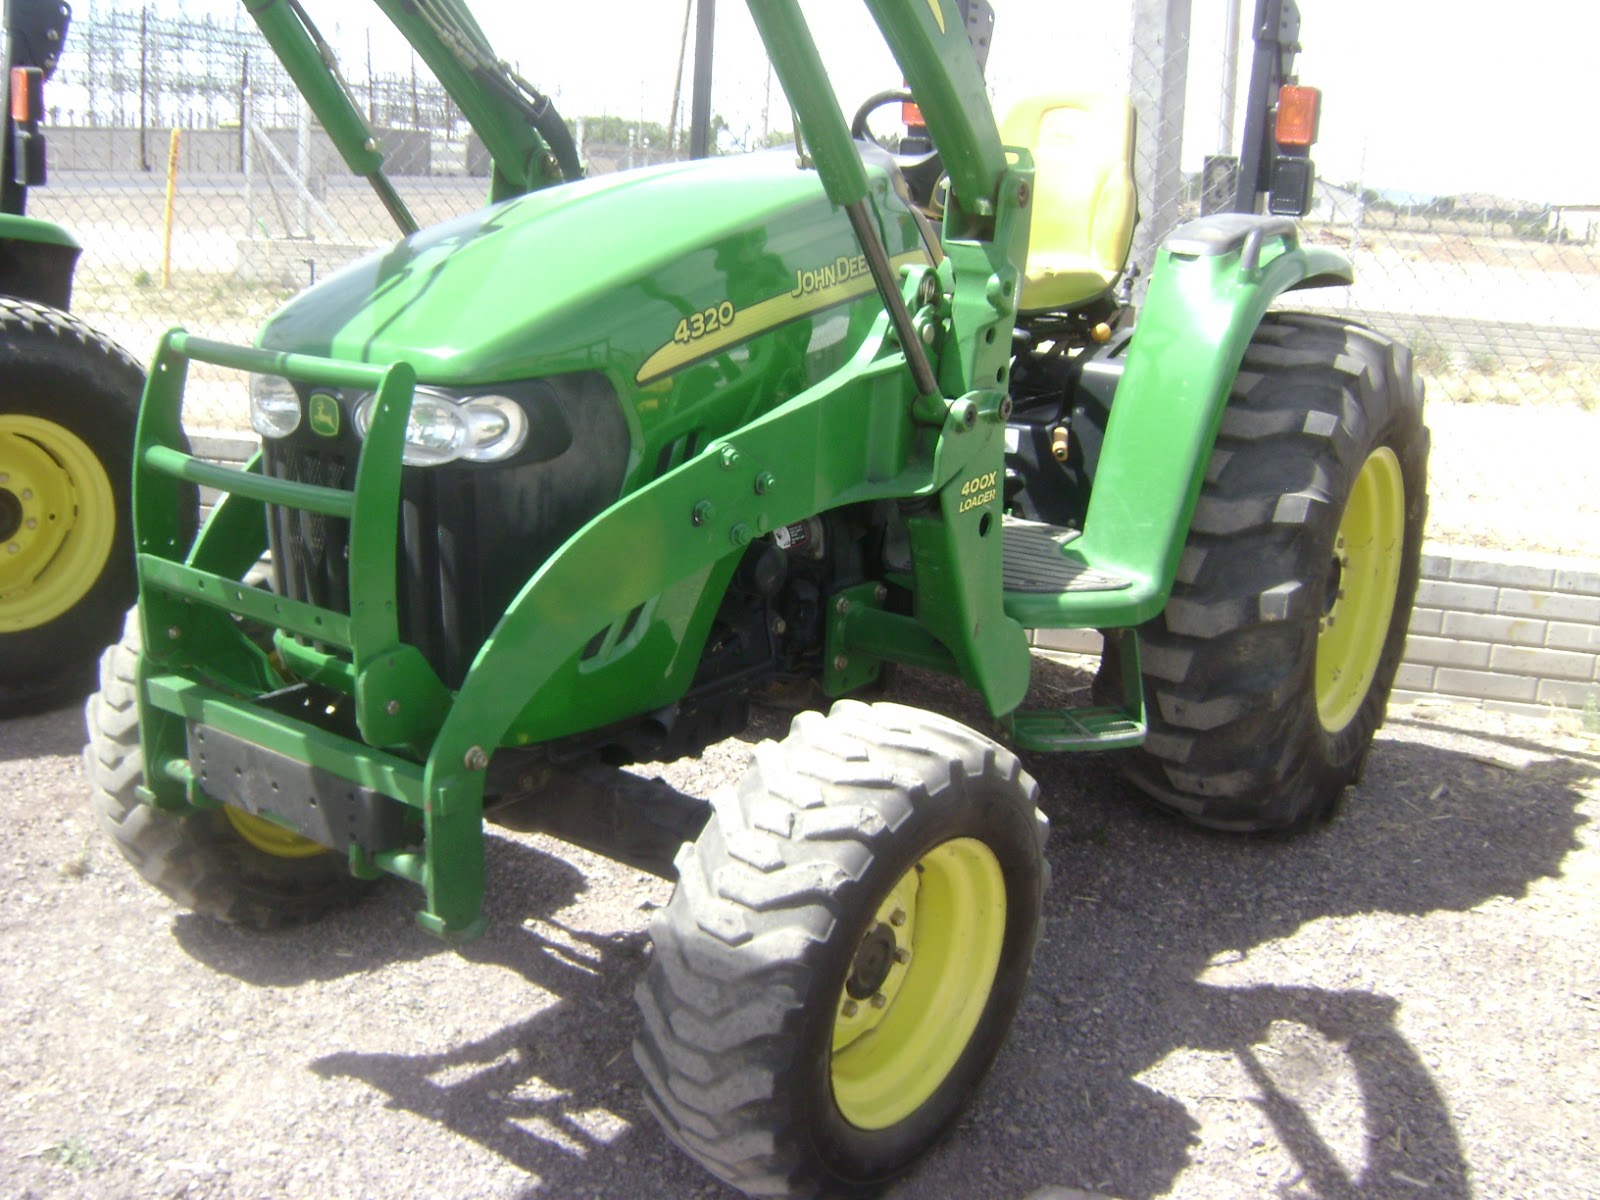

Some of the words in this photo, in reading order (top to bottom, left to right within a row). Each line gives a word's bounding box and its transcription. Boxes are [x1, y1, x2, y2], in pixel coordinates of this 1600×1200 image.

[791, 265, 836, 298] JOHN
[836, 255, 871, 282] DEE
[673, 300, 734, 343] 4320
[961, 470, 997, 496] 400X
[959, 489, 996, 513] LOADER
